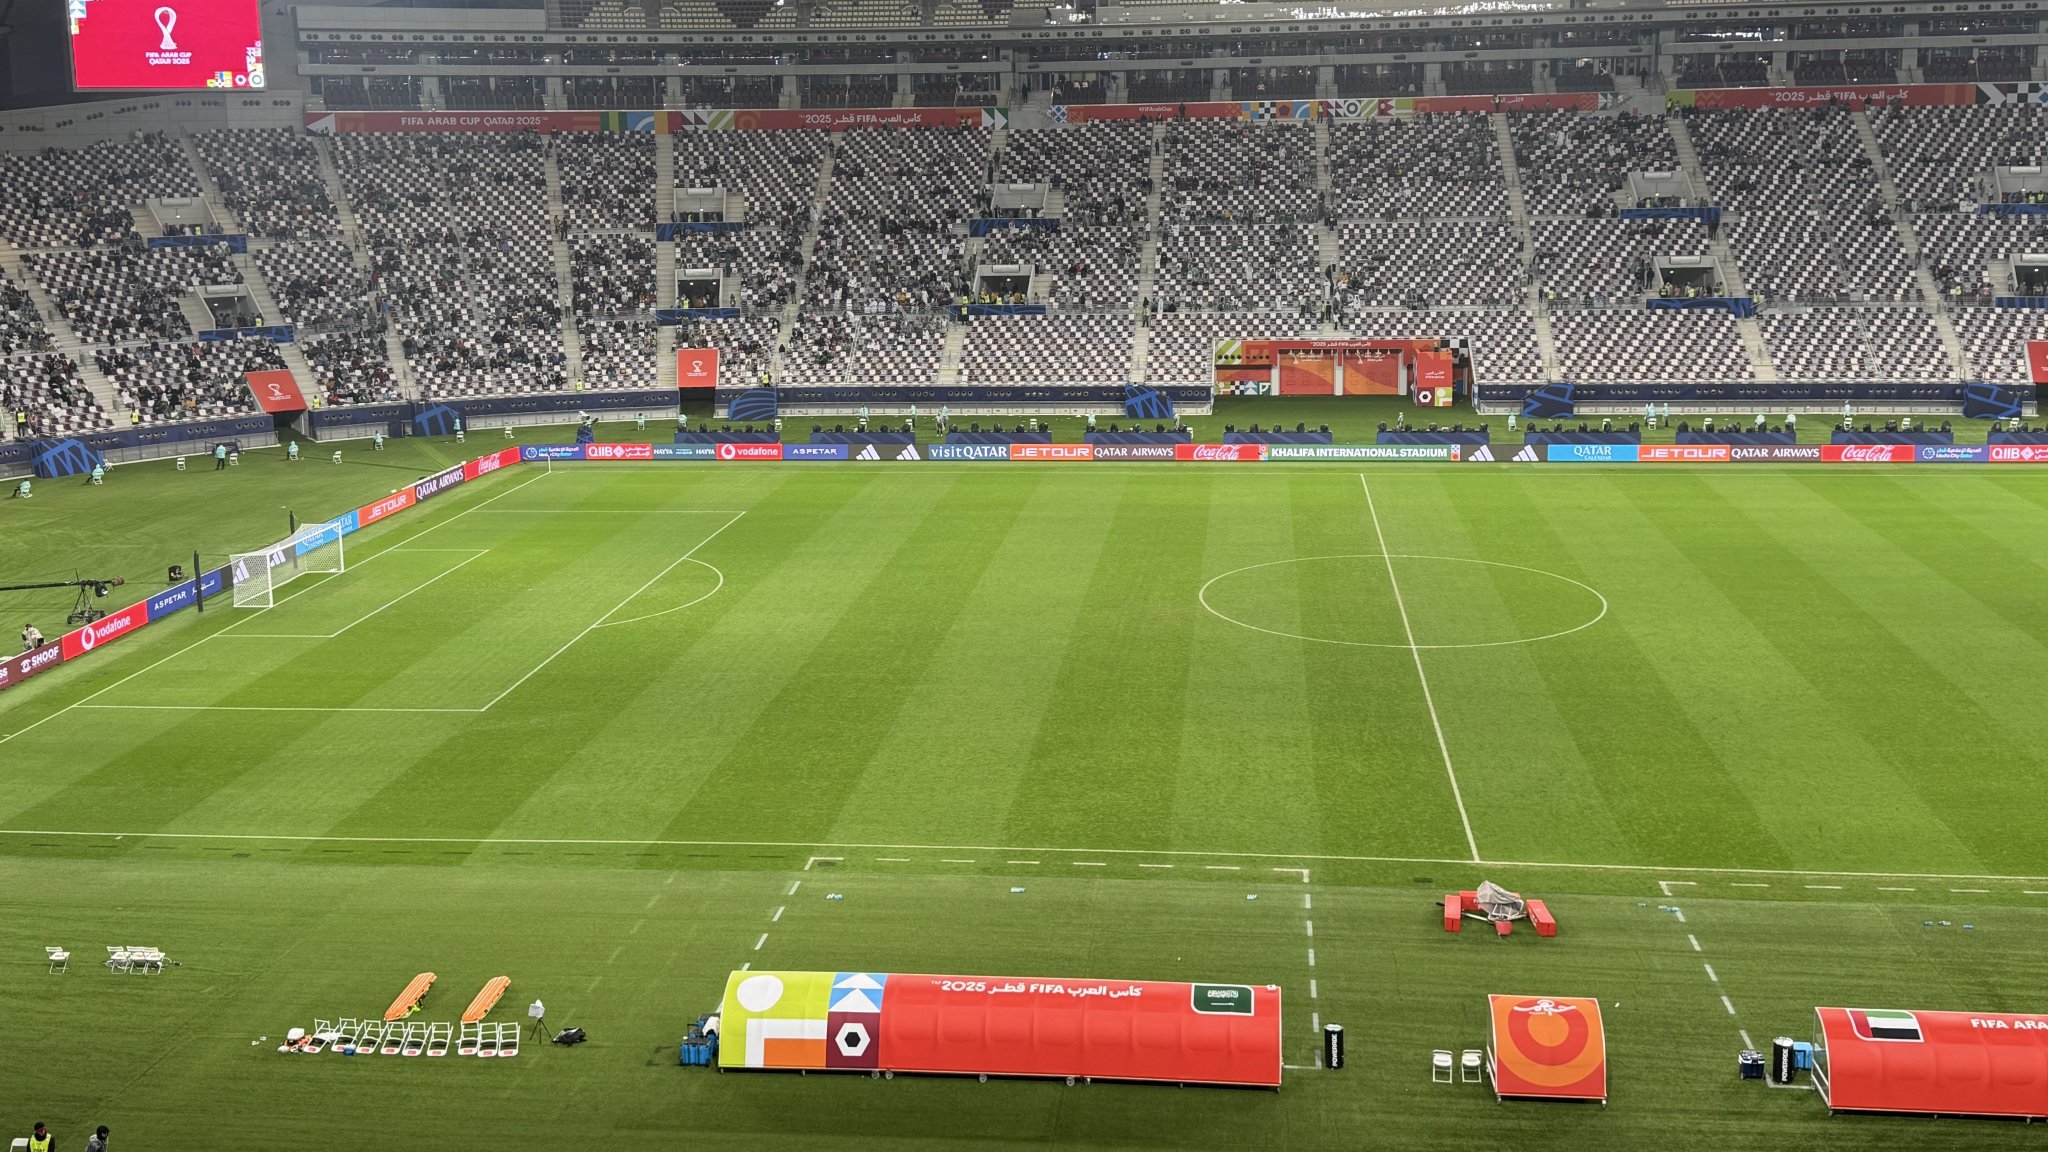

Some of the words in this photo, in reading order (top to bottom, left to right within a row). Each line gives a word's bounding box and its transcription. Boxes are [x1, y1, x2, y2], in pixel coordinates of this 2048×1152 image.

[149, 58, 171, 66] QATAR
[1806, 91, 1831, 102] قطر
[401, 117, 424, 126] FIFA
[427, 117, 457, 126] ARAB
[460, 117, 481, 125] CUP
[483, 117, 515, 127] QATAR
[833, 114, 855, 125] قطر
[857, 114, 877, 123] FIFA
[902, 113, 921, 124] كأس
[588, 446, 614, 457] QIIB
[737, 447, 778, 456] vodafone
[792, 447, 837, 455] ASPETAR
[1013, 447, 1090, 457] JETOUR
[1094, 447, 1128, 458] QATAR
[1131, 447, 1174, 457] AIRWAYS
[1272, 447, 1315, 458] KHALIFA
[1316, 447, 1399, 458] INTERNATIONAL
[1399, 447, 1447, 458] STADIUM
[1573, 445, 1612, 457] QATAR
[1641, 448, 1726, 458] JETOUR
[1731, 447, 1768, 459] QATAR
[1773, 447, 1819, 458] AIRWAYS
[1992, 447, 2020, 459] QIIB
[416, 480, 438, 500] QATAR
[438, 468, 464, 489] AIRWAYS
[368, 494, 407, 519] JETOUR
[154, 590, 187, 611] ASPETAR
[96, 615, 131, 639] vodafone
[31, 645, 59, 667] SHOOF
[988, 982, 1026, 995] قطر
[1029, 983, 1065, 993] FIFA
[1067, 985, 1107, 997] العرب
[1109, 985, 1142, 999] كأس
[1970, 1018, 2010, 1029] FIFA
[1781, 1048, 1789, 1082] POWERADE
